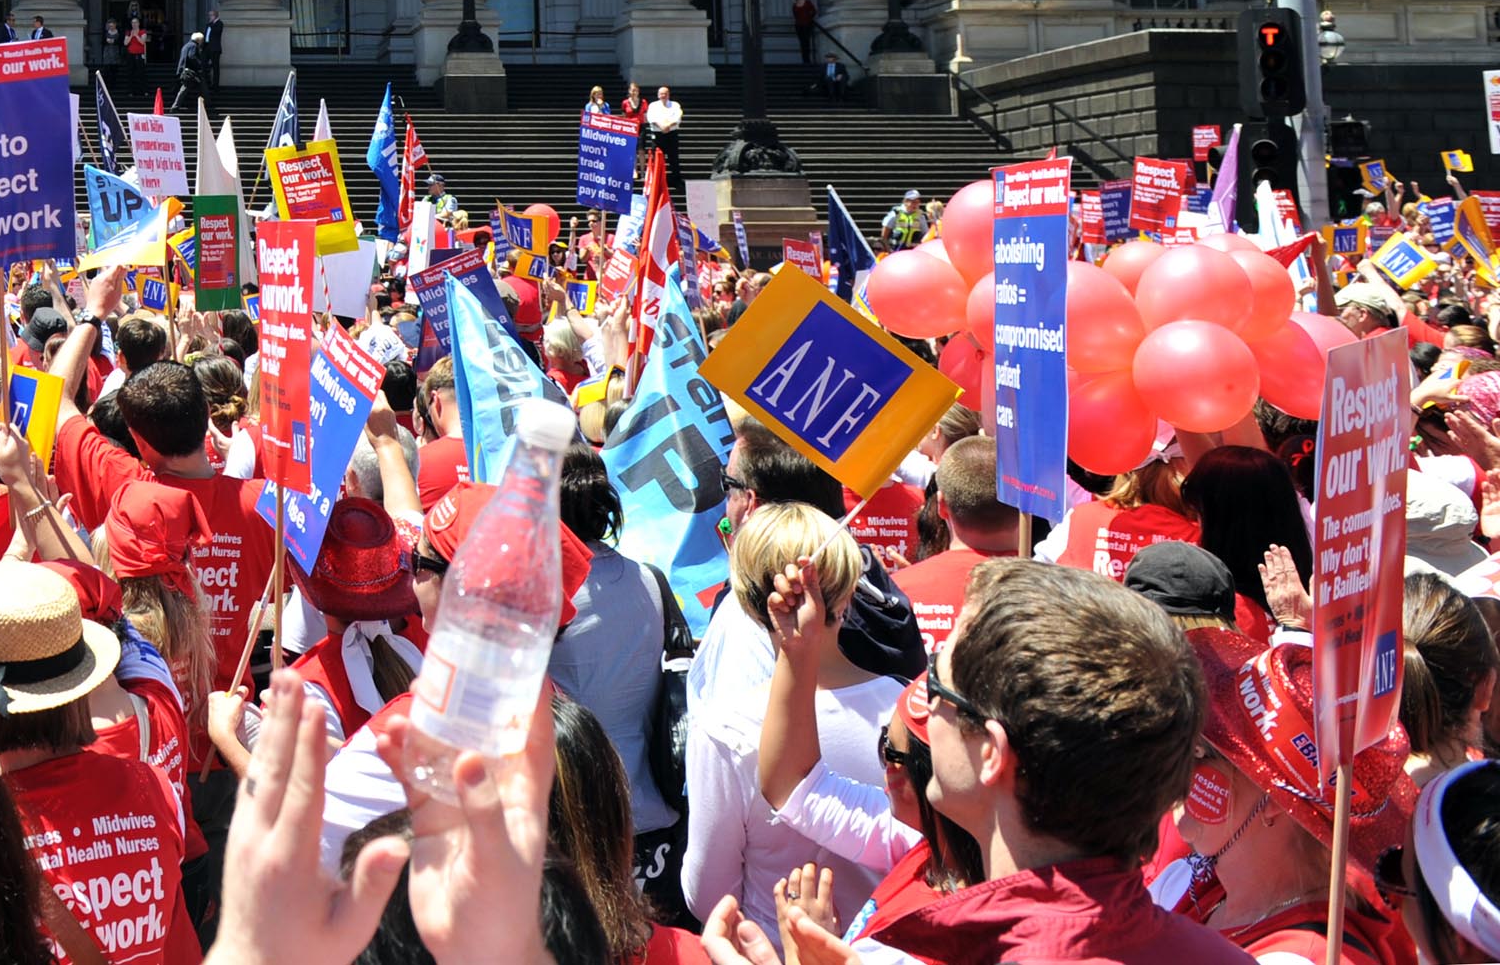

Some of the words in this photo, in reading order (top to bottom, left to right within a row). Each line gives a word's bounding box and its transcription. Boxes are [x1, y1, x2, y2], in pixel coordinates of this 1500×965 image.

[2, 61, 25, 74] our
[29, 54, 65, 71] work.
[0, 134, 28, 158] to
[582, 128, 627, 146] Midwives
[581, 144, 607, 157] won't
[278, 155, 322, 173] Respect
[282, 173, 300, 185] our
[302, 166, 332, 181] work.
[580, 157, 605, 170] trade
[1136, 162, 1176, 177] Respect
[579, 186, 596, 198] pay
[580, 172, 606, 185] ratios
[608, 177, 622, 188] for
[1135, 175, 1152, 185] our
[1153, 176, 1180, 190] work.
[100, 189, 143, 222] UP
[995, 237, 1045, 272] abolishing
[1334, 236, 1357, 252] ANF
[1380, 246, 1416, 278] ANF
[996, 278, 1018, 306] ratios
[995, 322, 1064, 353] compromised
[311, 354, 356, 414] Midwives
[995, 359, 1020, 390] patient
[751, 339, 881, 448] ANF
[1331, 363, 1398, 438] Respect
[996, 405, 1014, 429] care
[1326, 447, 1362, 499] our
[320, 498, 329, 516] a
[850, 526, 878, 537] Health
[879, 527, 908, 537] Nurses
[867, 517, 908, 526] Midwives
[1323, 516, 1340, 541] The
[211, 546, 241, 558] Nurses
[1321, 549, 1340, 574] Why
[1343, 542, 1368, 564] don't
[1319, 583, 1332, 607] Mr
[913, 602, 954, 615] Nurses
[1374, 650, 1395, 695] ANF
[1239, 675, 1278, 741] work.
[1193, 784, 1216, 801] Nurses
[1194, 773, 1230, 797] respect
[1189, 792, 1220, 815] Midwives
[92, 812, 156, 836] Midwives
[66, 839, 113, 865] Health
[116, 836, 160, 855] Nurses
[52, 857, 165, 921] espect
[95, 903, 166, 953] work.
